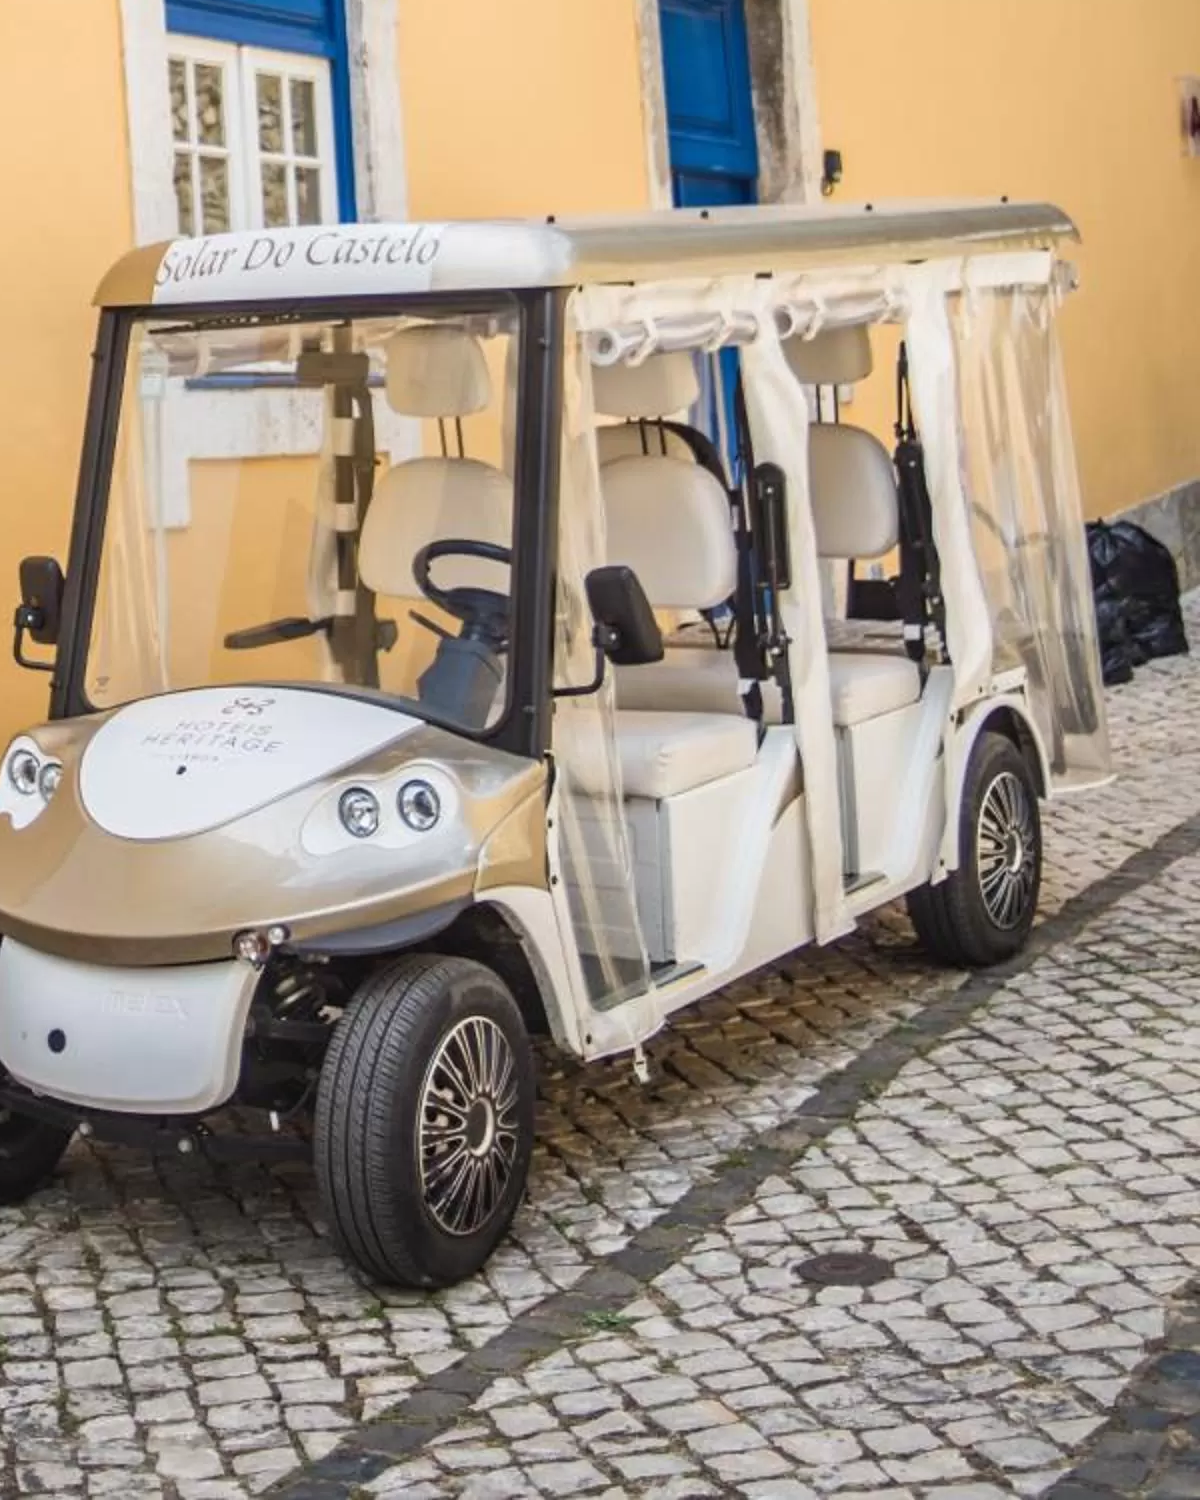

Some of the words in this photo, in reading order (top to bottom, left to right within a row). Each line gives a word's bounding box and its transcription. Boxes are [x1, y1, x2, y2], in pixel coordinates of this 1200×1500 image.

[154, 239, 237, 286] Solar
[242, 237, 295, 271] Do
[306, 226, 442, 266] Castelo
[141, 733, 283, 752] HERITAGE
